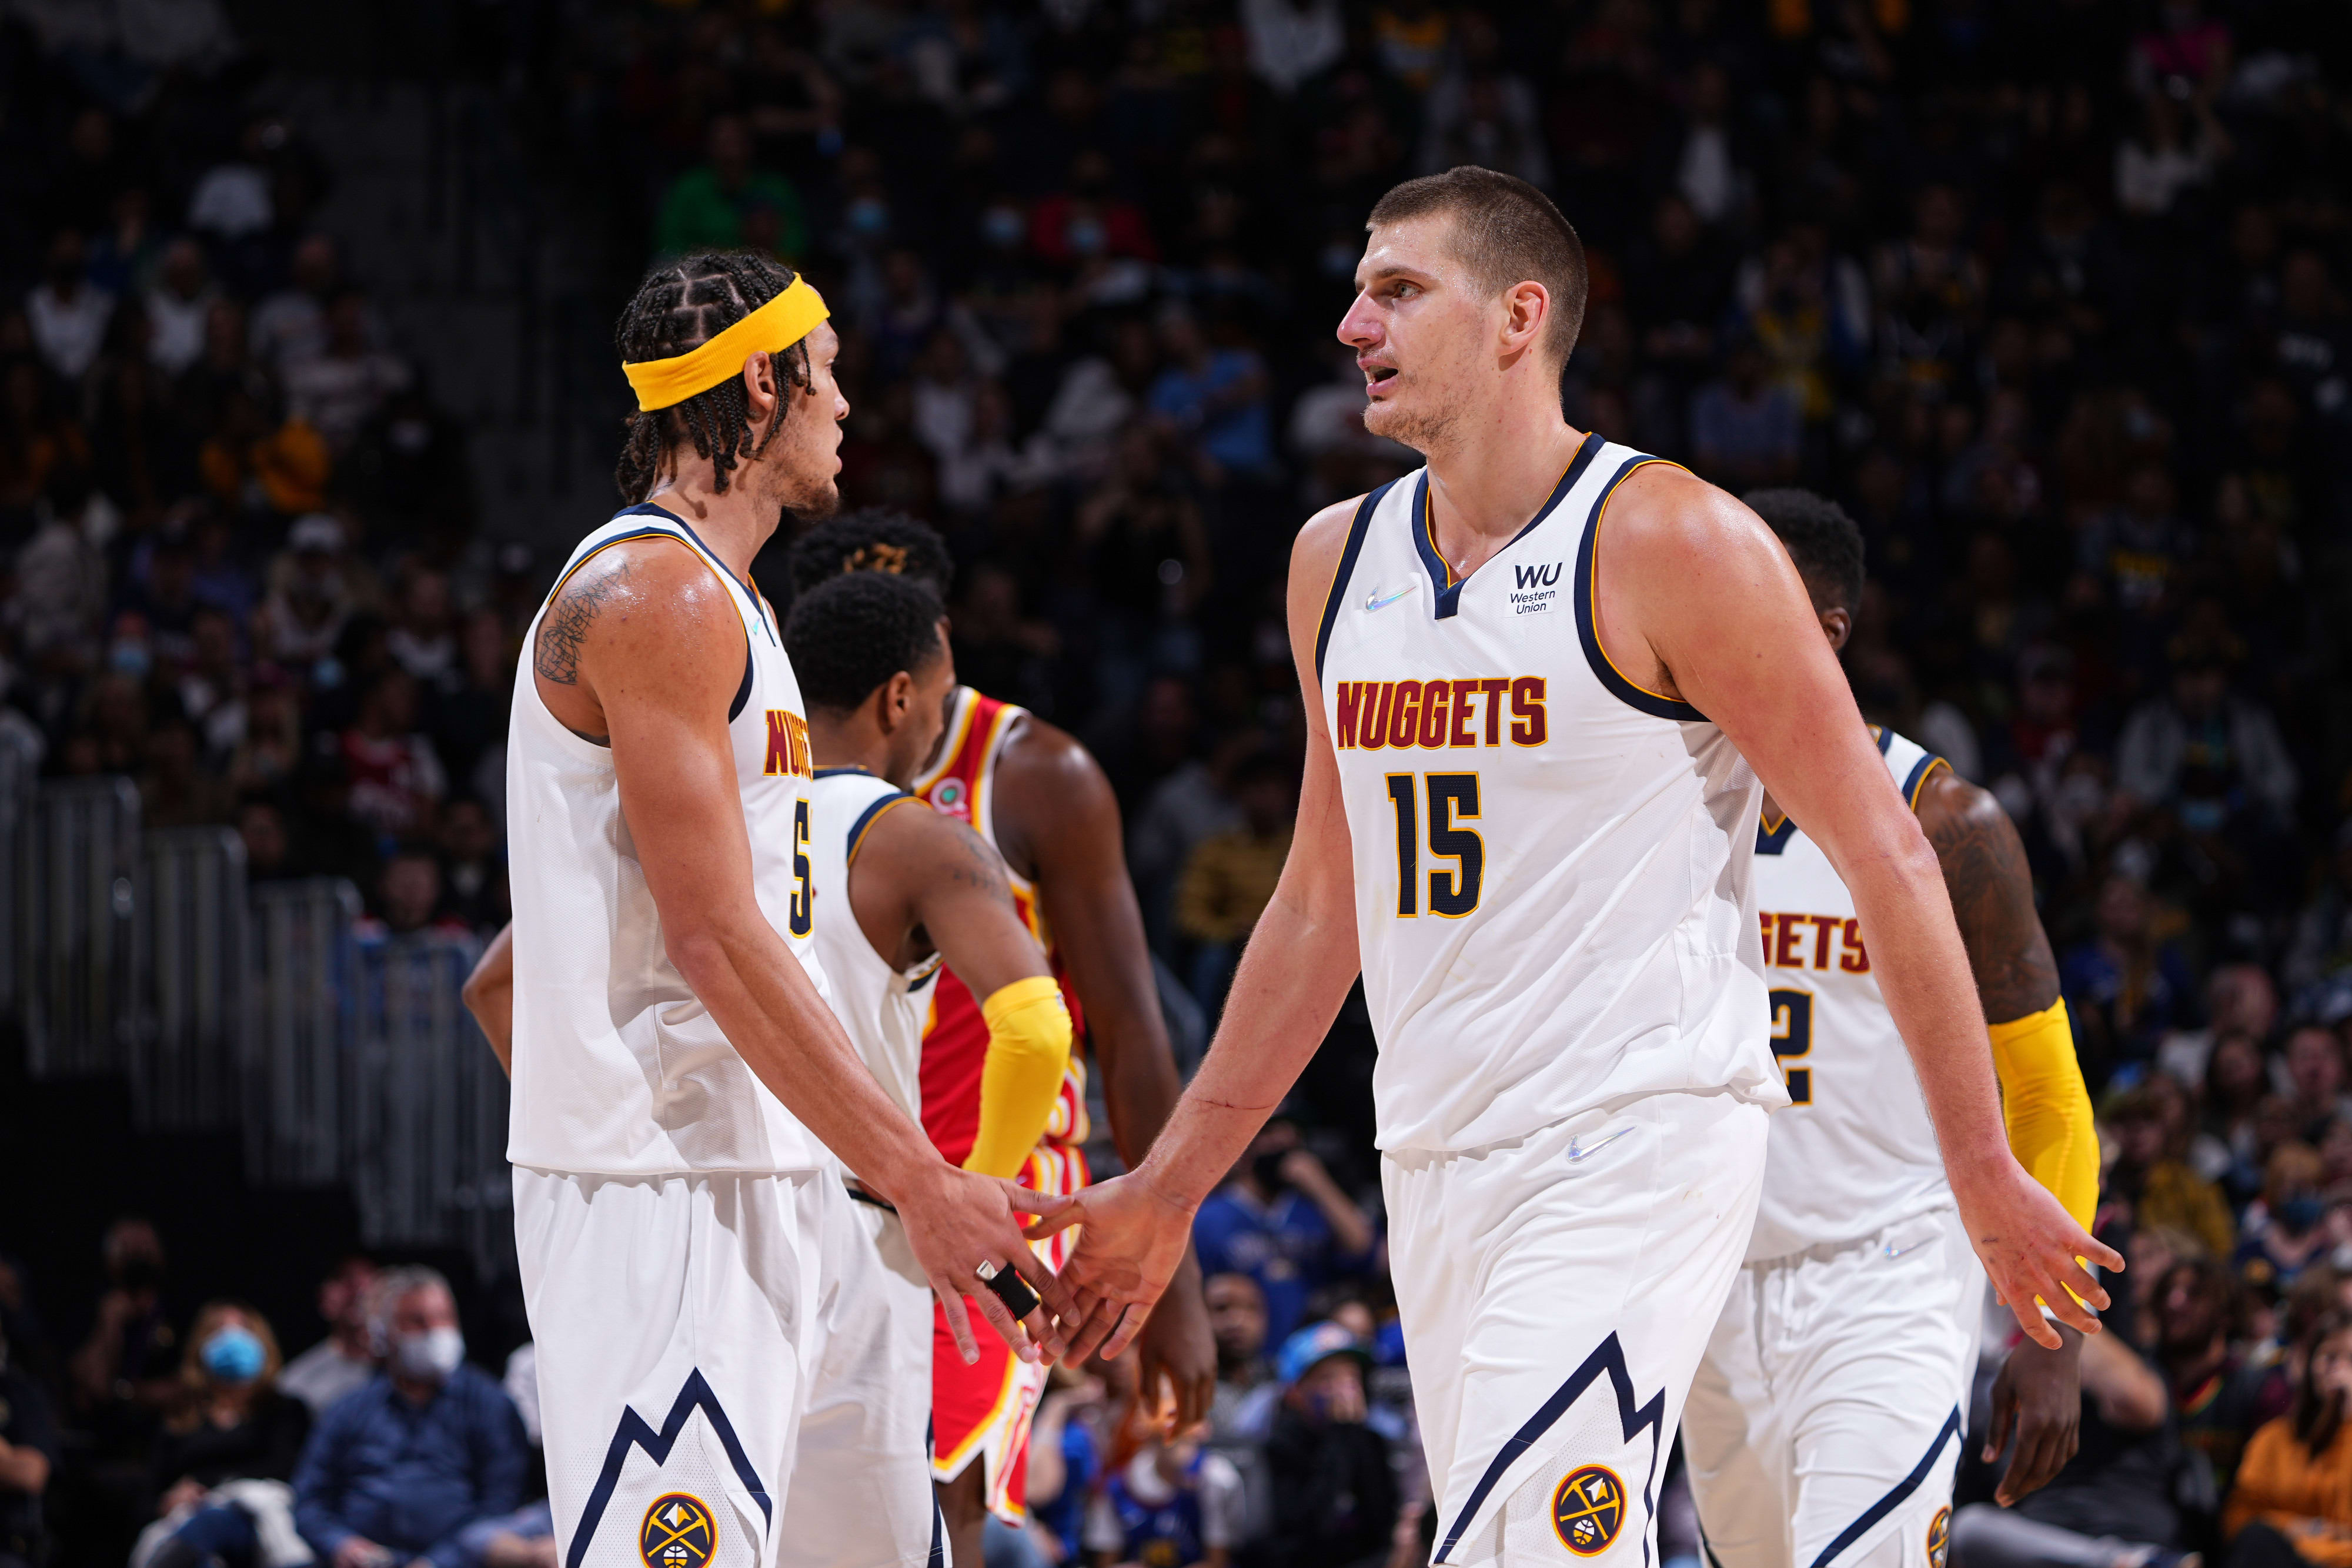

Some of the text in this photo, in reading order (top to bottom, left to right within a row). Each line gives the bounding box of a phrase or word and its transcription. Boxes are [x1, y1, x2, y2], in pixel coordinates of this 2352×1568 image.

[1515, 562, 1562, 589] WU
[1511, 590, 1555, 603] Western
[1517, 602, 1546, 614] Union
[1337, 676, 1548, 750] NUGGETS
[1384, 771, 1485, 919] 15
